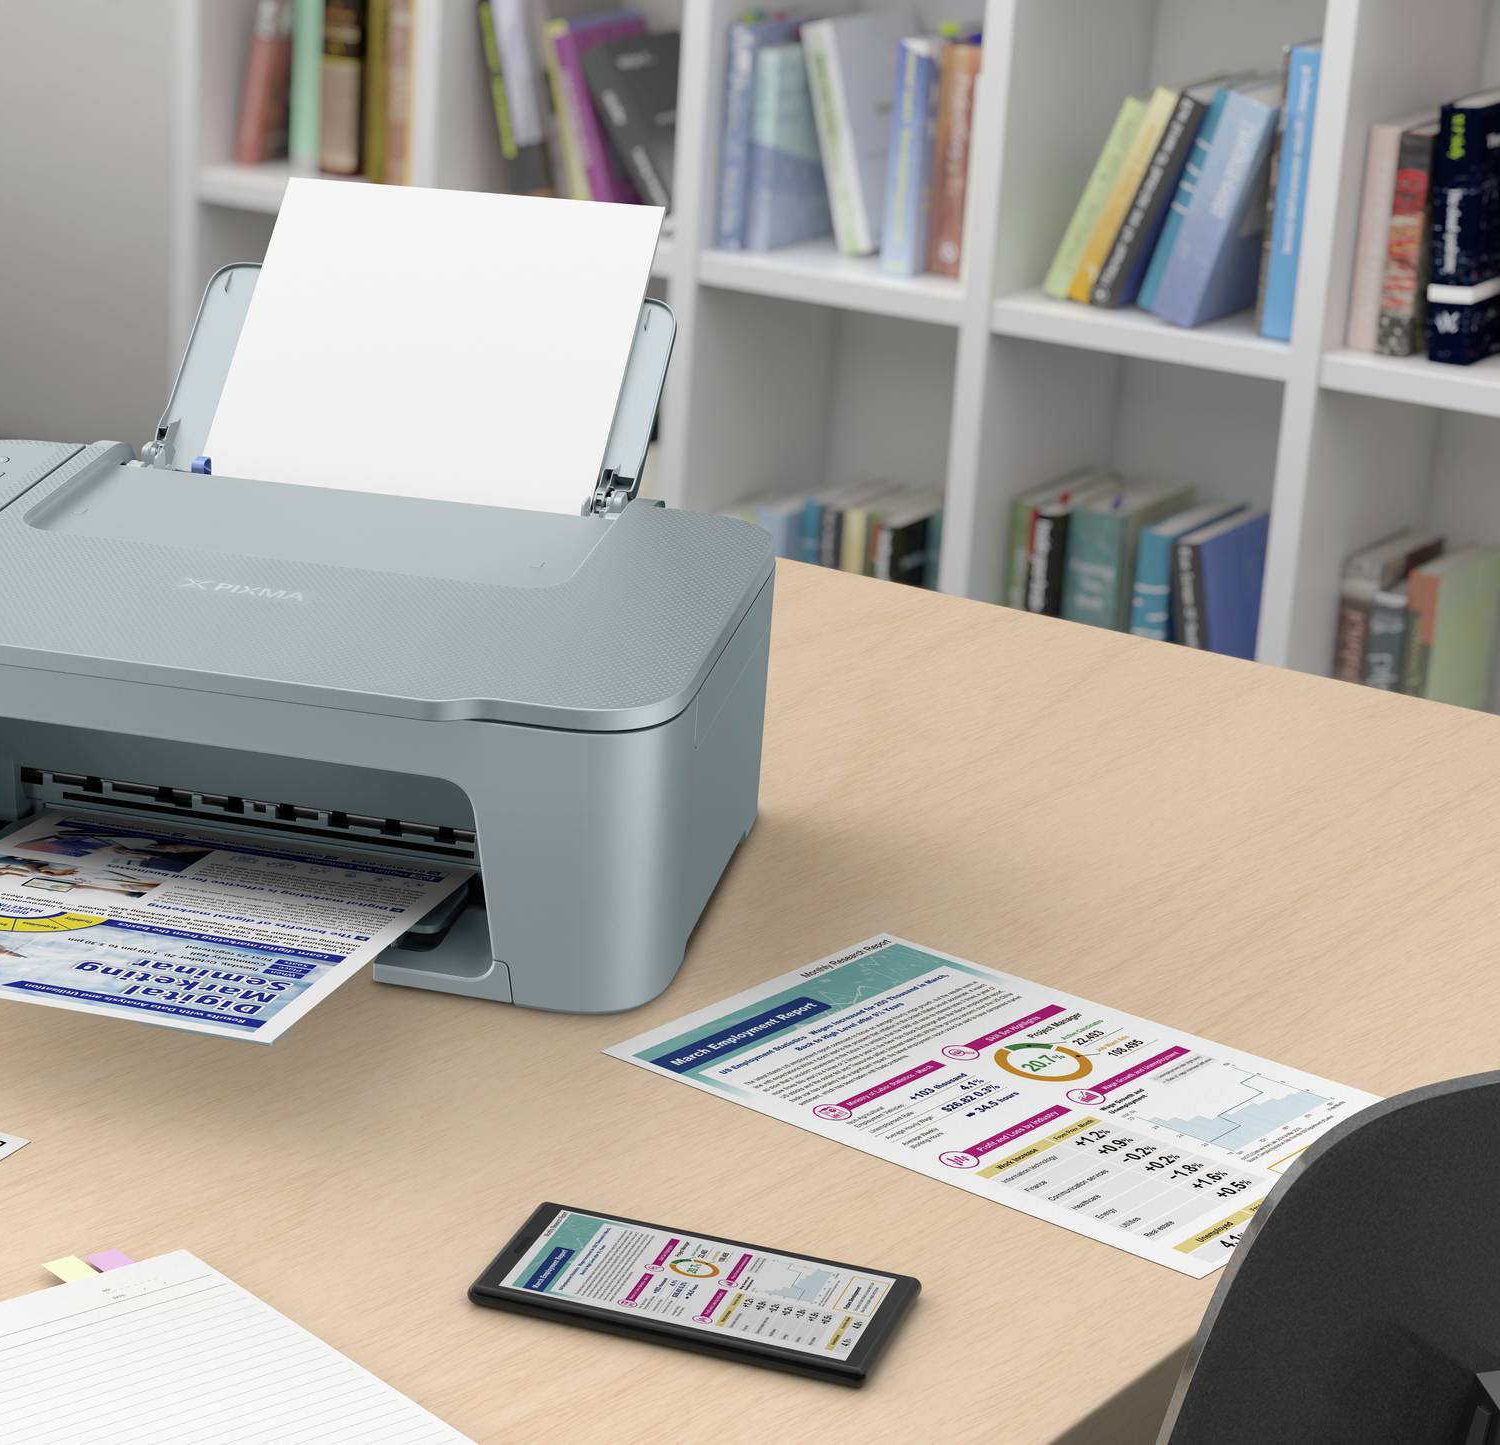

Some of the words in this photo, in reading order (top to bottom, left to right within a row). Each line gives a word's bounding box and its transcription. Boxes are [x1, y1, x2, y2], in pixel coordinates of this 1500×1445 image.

[214, 582, 303, 601] PIXMA
[145, 902, 212, 916] marketing
[212, 912, 255, 923] digital
[116, 922, 151, 930] basics
[171, 930, 199, 938] from
[273, 922, 327, 934] benefits
[200, 934, 258, 947] marketing
[257, 944, 295, 953] digital
[295, 950, 329, 959] Learn
[799, 963, 835, 978] Monthly
[827, 949, 868, 966] Research
[862, 938, 893, 951] Report
[72, 960, 278, 1003] Marketing
[129, 958, 291, 991] Seminar
[22, 982, 79, 995] Utilisation
[102, 996, 149, 1007] Analysis
[122, 983, 264, 1015] Digital
[148, 1003, 177, 1012] Data
[177, 1008, 204, 1016] with
[205, 1013, 246, 1023] Results
[668, 1047, 712, 1065] March
[706, 1018, 782, 1050] Employment
[774, 1002, 819, 1021] Report
[984, 1033, 1002, 1041] Skill
[1008, 1015, 1042, 1030] Highlights
[1025, 1025, 1056, 1038] Project
[1049, 1012, 1084, 1027] Manager
[1070, 1029, 1106, 1045] 22,493
[1019, 1052, 1067, 1072] 20.7%
[907, 1087, 936, 1100] +103
[931, 1072, 969, 1089] thousand
[958, 1078, 985, 1090] 4.1%
[939, 1094, 978, 1112] $26.82
[971, 1083, 1001, 1097] 0.3%
[973, 1100, 1000, 1112] 34.5
[995, 1091, 1020, 1102] hours
[1071, 1128, 1113, 1146] +1.2%
[994, 1159, 1015, 1169] Work
[1010, 1148, 1040, 1162] Increase
[1022, 1180, 1049, 1192] Finance
[1095, 1136, 1136, 1155] +0.9%
[1141, 1153, 1182, 1171] +0.2%
[1045, 1178, 1093, 1201] Communication
[1084, 1168, 1110, 1181] services
[1189, 1170, 1230, 1189] +1.6%
[1093, 1207, 1119, 1219] Energy
[1141, 1228, 1160, 1237] Real
[1154, 1220, 1176, 1230] estate
[1213, 1178, 1254, 1198] +0.5%
[1192, 1220, 1236, 1242] Unemployed
